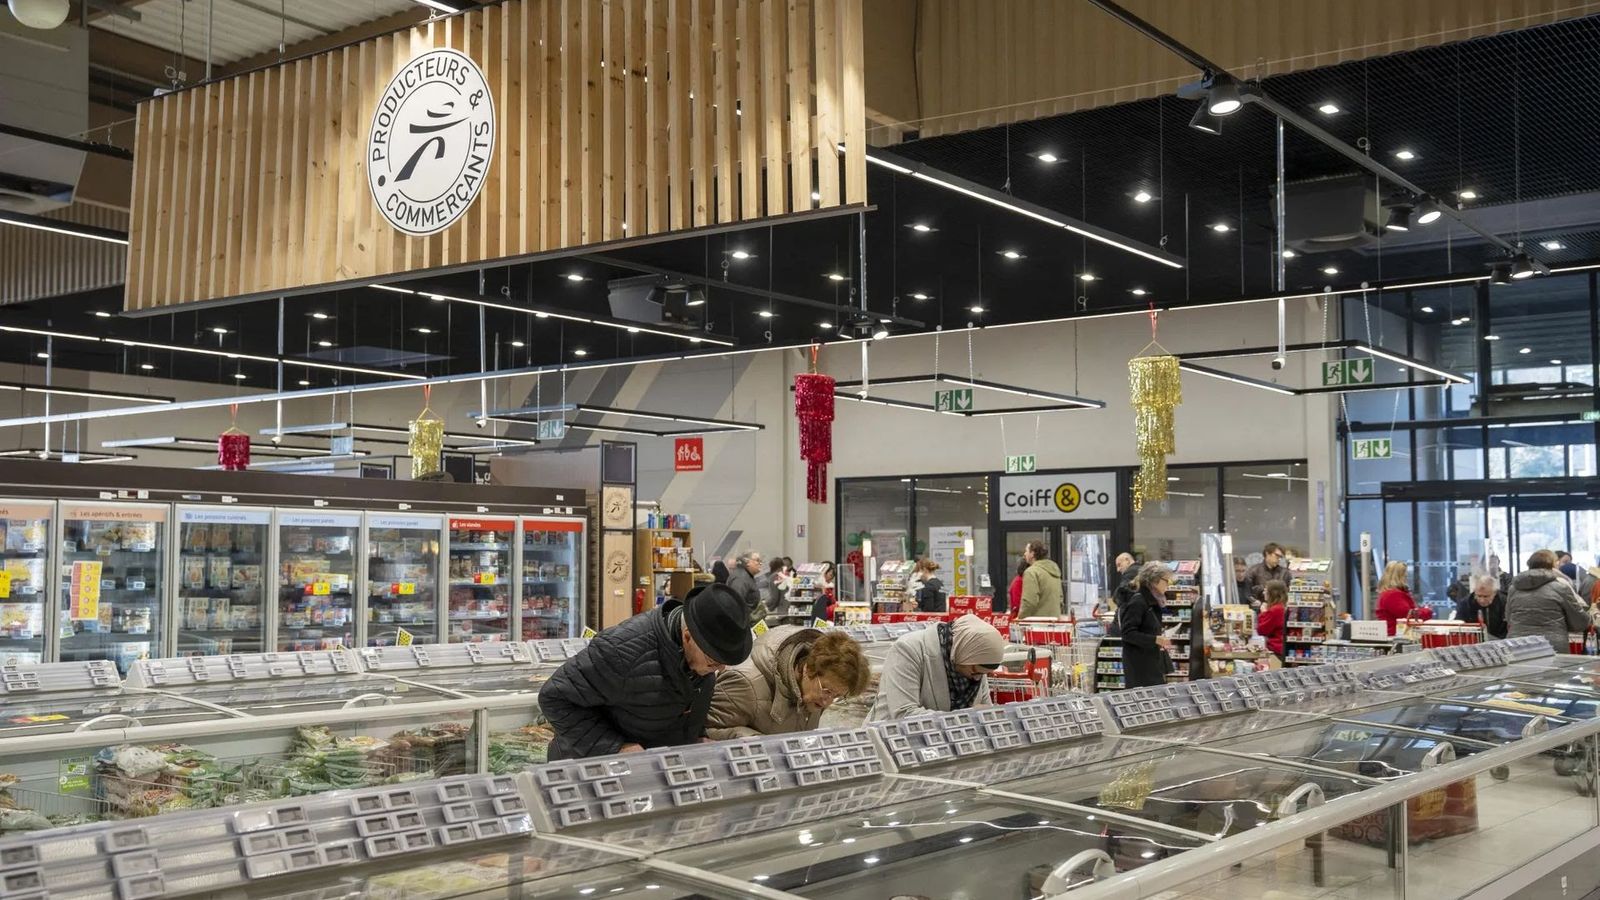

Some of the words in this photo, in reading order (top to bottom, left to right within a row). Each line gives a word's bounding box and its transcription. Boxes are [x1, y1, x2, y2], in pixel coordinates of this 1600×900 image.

[372, 56, 470, 162] PRODUCTEURS
[469, 89, 483, 109] &
[386, 121, 489, 227] COMMERÇANTS
[1004, 489, 1052, 508] Coiff
[1060, 488, 1075, 507] &
[1083, 489, 1109, 505] Co
